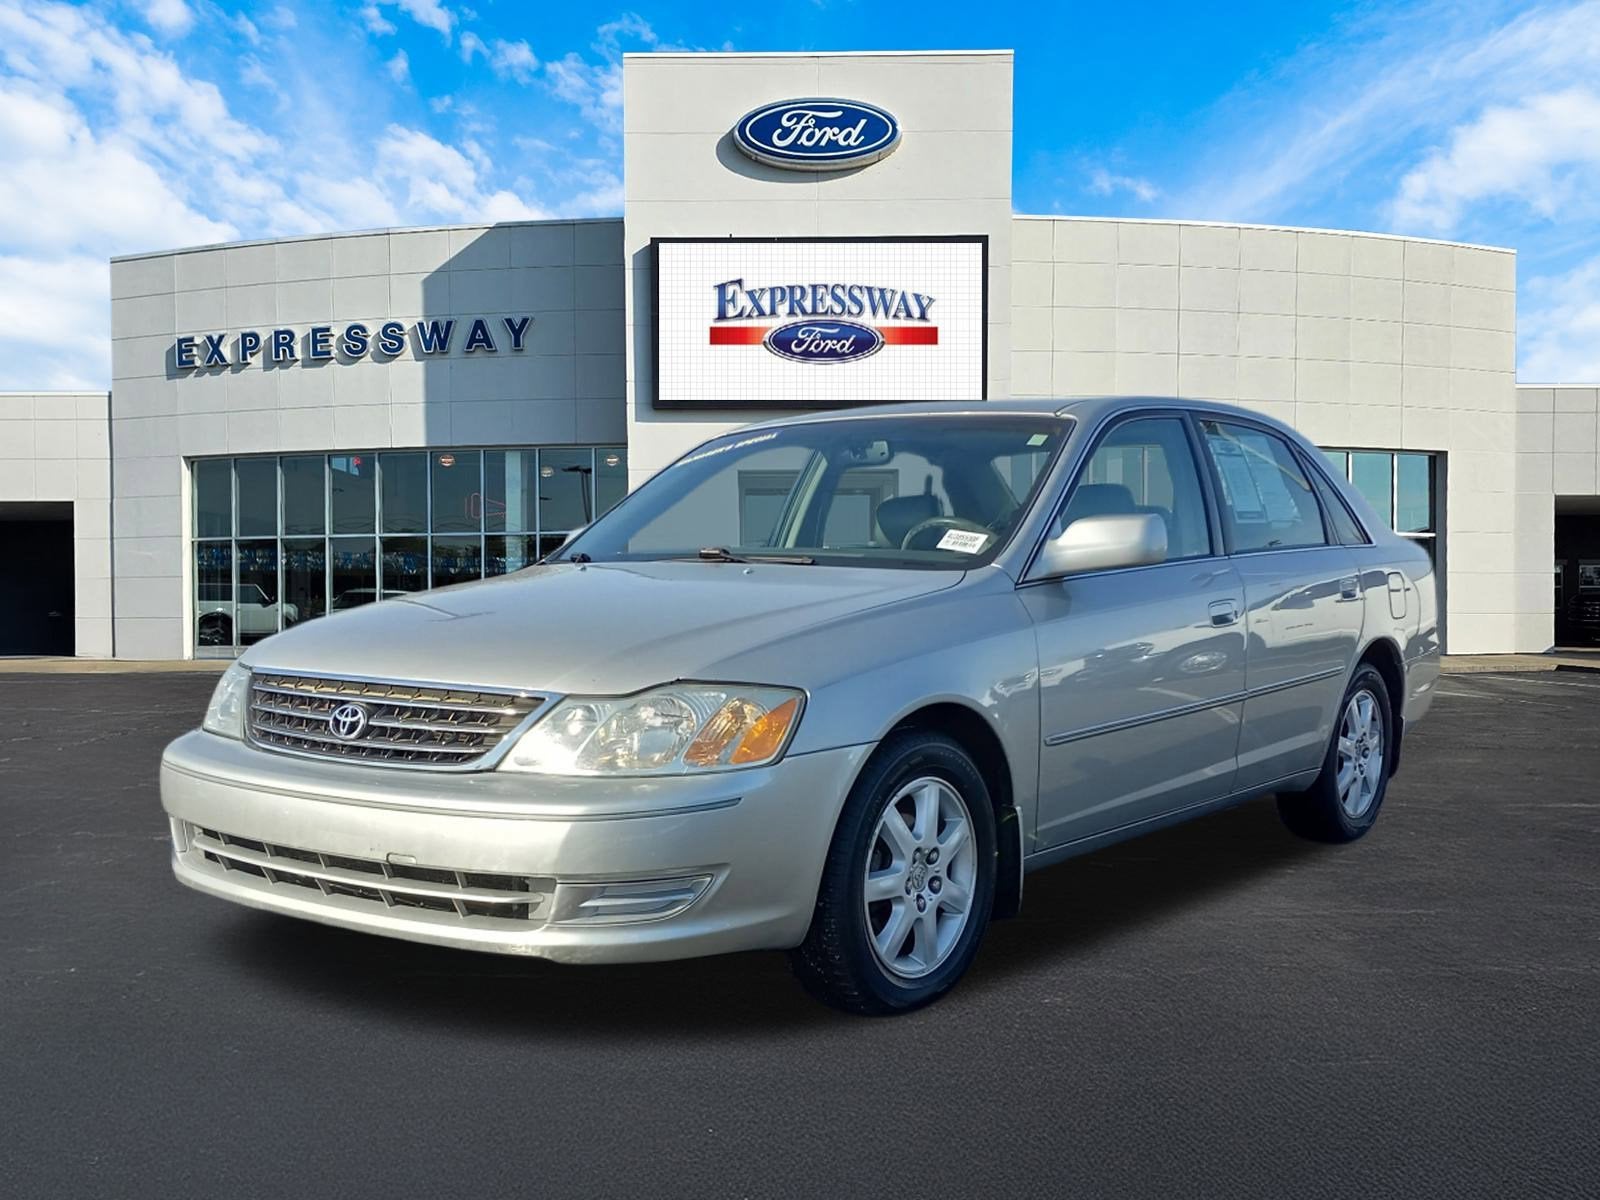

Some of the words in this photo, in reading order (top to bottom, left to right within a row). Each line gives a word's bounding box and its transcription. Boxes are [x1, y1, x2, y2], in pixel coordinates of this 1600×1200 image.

[772, 110, 867, 147] Ford
[714, 278, 935, 322] EXPRESSWAY
[176, 315, 533, 368] EXPRESSWAY
[791, 326, 855, 353] Ford
